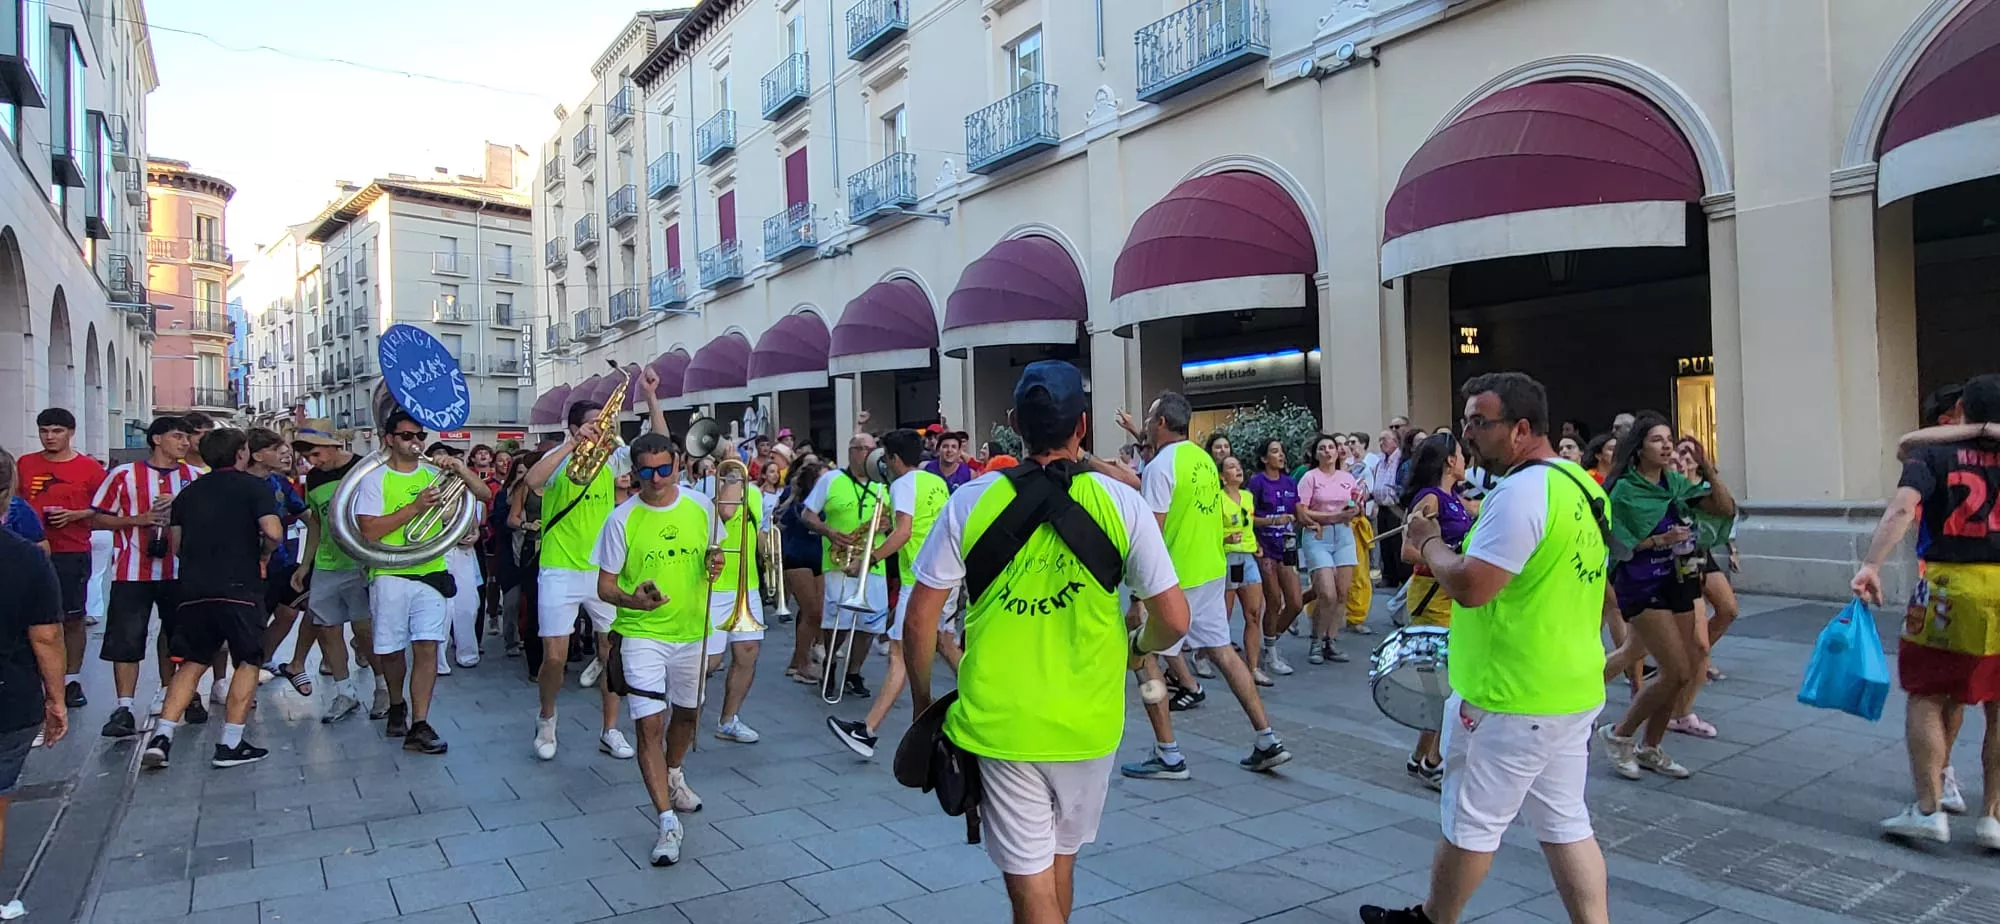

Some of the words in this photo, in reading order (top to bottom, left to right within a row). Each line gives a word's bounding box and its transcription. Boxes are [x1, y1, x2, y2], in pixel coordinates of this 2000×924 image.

[522, 325, 531, 376] HOSTAL
[1183, 373, 1214, 384] puestas
[1215, 369, 1228, 381] del
[1229, 367, 1257, 379] Estado
